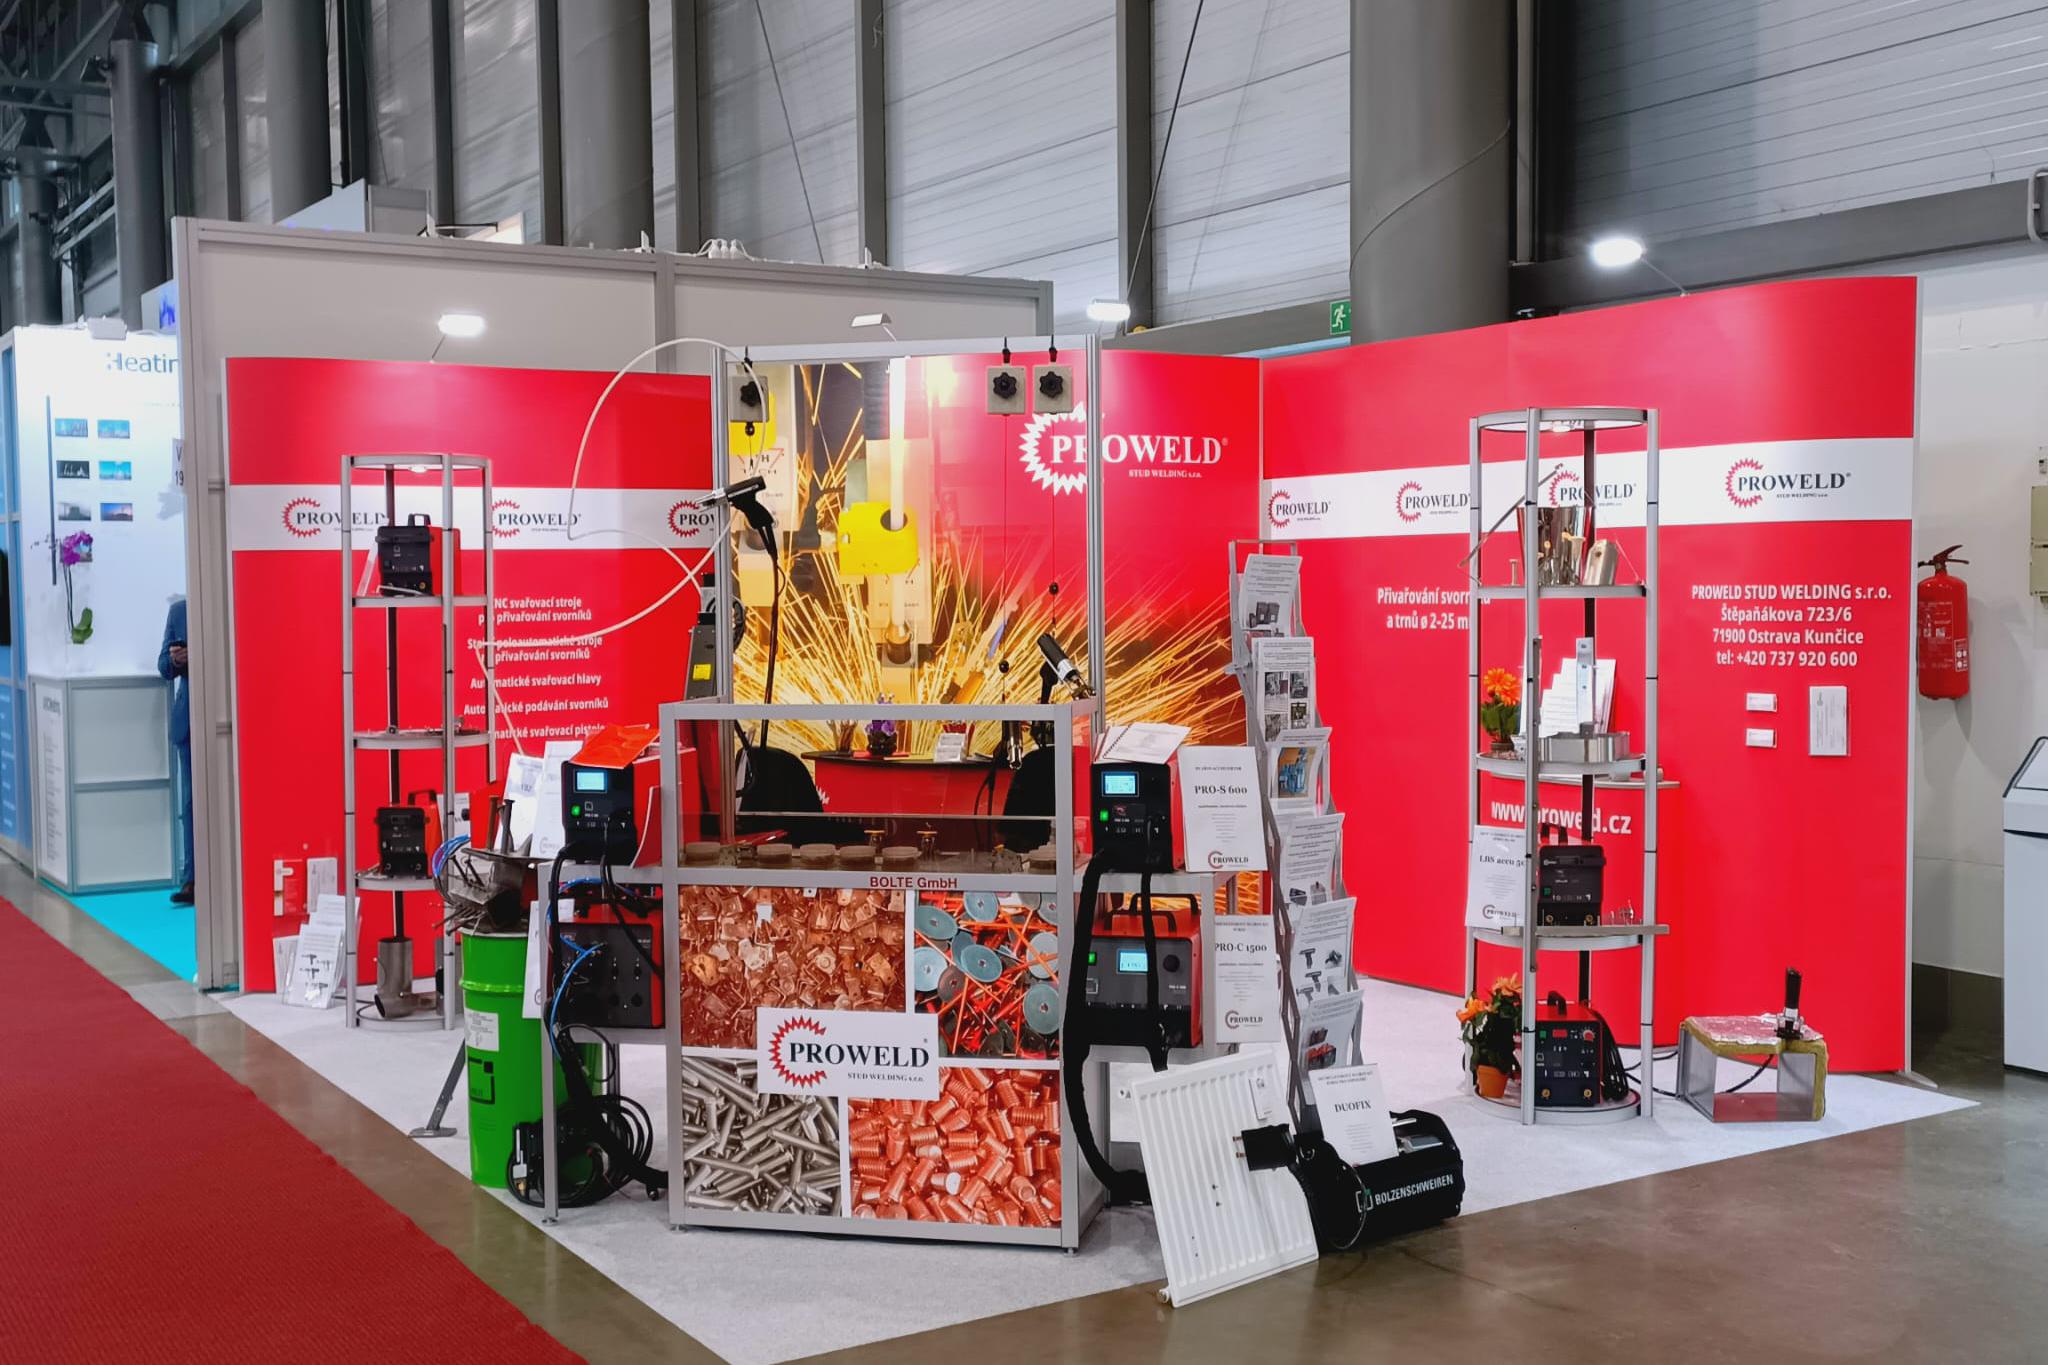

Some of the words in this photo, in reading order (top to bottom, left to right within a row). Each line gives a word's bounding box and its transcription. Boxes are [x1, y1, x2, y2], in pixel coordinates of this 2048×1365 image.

[1050, 434, 1222, 464] PROWELD
[1128, 469, 1150, 478] STUD
[1151, 469, 1187, 478] WELDING
[1739, 473, 1846, 492] PROWELD
[1276, 501, 1329, 516] PROWELD
[1405, 493, 1468, 509] PROWELD
[499, 513, 578, 526] PROWELD
[1377, 587, 1440, 605] Přivařování
[1692, 584, 1742, 600] PROWELD
[1744, 585, 1777, 600] STUD
[1780, 585, 1852, 600] WELDING
[1854, 586, 1892, 600] s.r.o.
[510, 597, 554, 609] svařovací
[556, 597, 582, 610] stroje
[496, 611, 550, 626] přivařování
[552, 609, 592, 621] svorníků
[1387, 615, 1394, 629] a
[1395, 610, 1419, 629] trnů
[1430, 612, 1455, 630] 2-25
[1721, 603, 1803, 625] Štěpaňákova
[1807, 606, 1853, 622] 723/6
[1713, 628, 1746, 644] 71900
[1748, 629, 1801, 644] Ostrava
[1804, 629, 1864, 645] Kunčice
[495, 650, 549, 665] přivařování
[550, 648, 591, 661] svorníků
[1716, 650, 1735, 665] tel:
[1736, 651, 1767, 666] +420
[1770, 651, 1795, 666] 737
[1799, 652, 1826, 667] 920
[1829, 652, 1858, 667] 600
[531, 674, 576, 687] svařovací
[577, 673, 602, 686] hlavy
[525, 699, 568, 714] podávání
[569, 697, 609, 711] svorníků
[530, 723, 573, 737] svařovací
[1195, 785, 1227, 795] PRO-S
[1228, 786, 1248, 795] 600
[869, 876, 914, 889] BOLTE
[916, 877, 958, 889] GmbH
[1246, 944, 1268, 953] 1500
[789, 1042, 930, 1068] PROWELD
[847, 1072, 868, 1080] STUD
[869, 1073, 905, 1081] WELDING
[1334, 1100, 1372, 1113] DUOFIX
